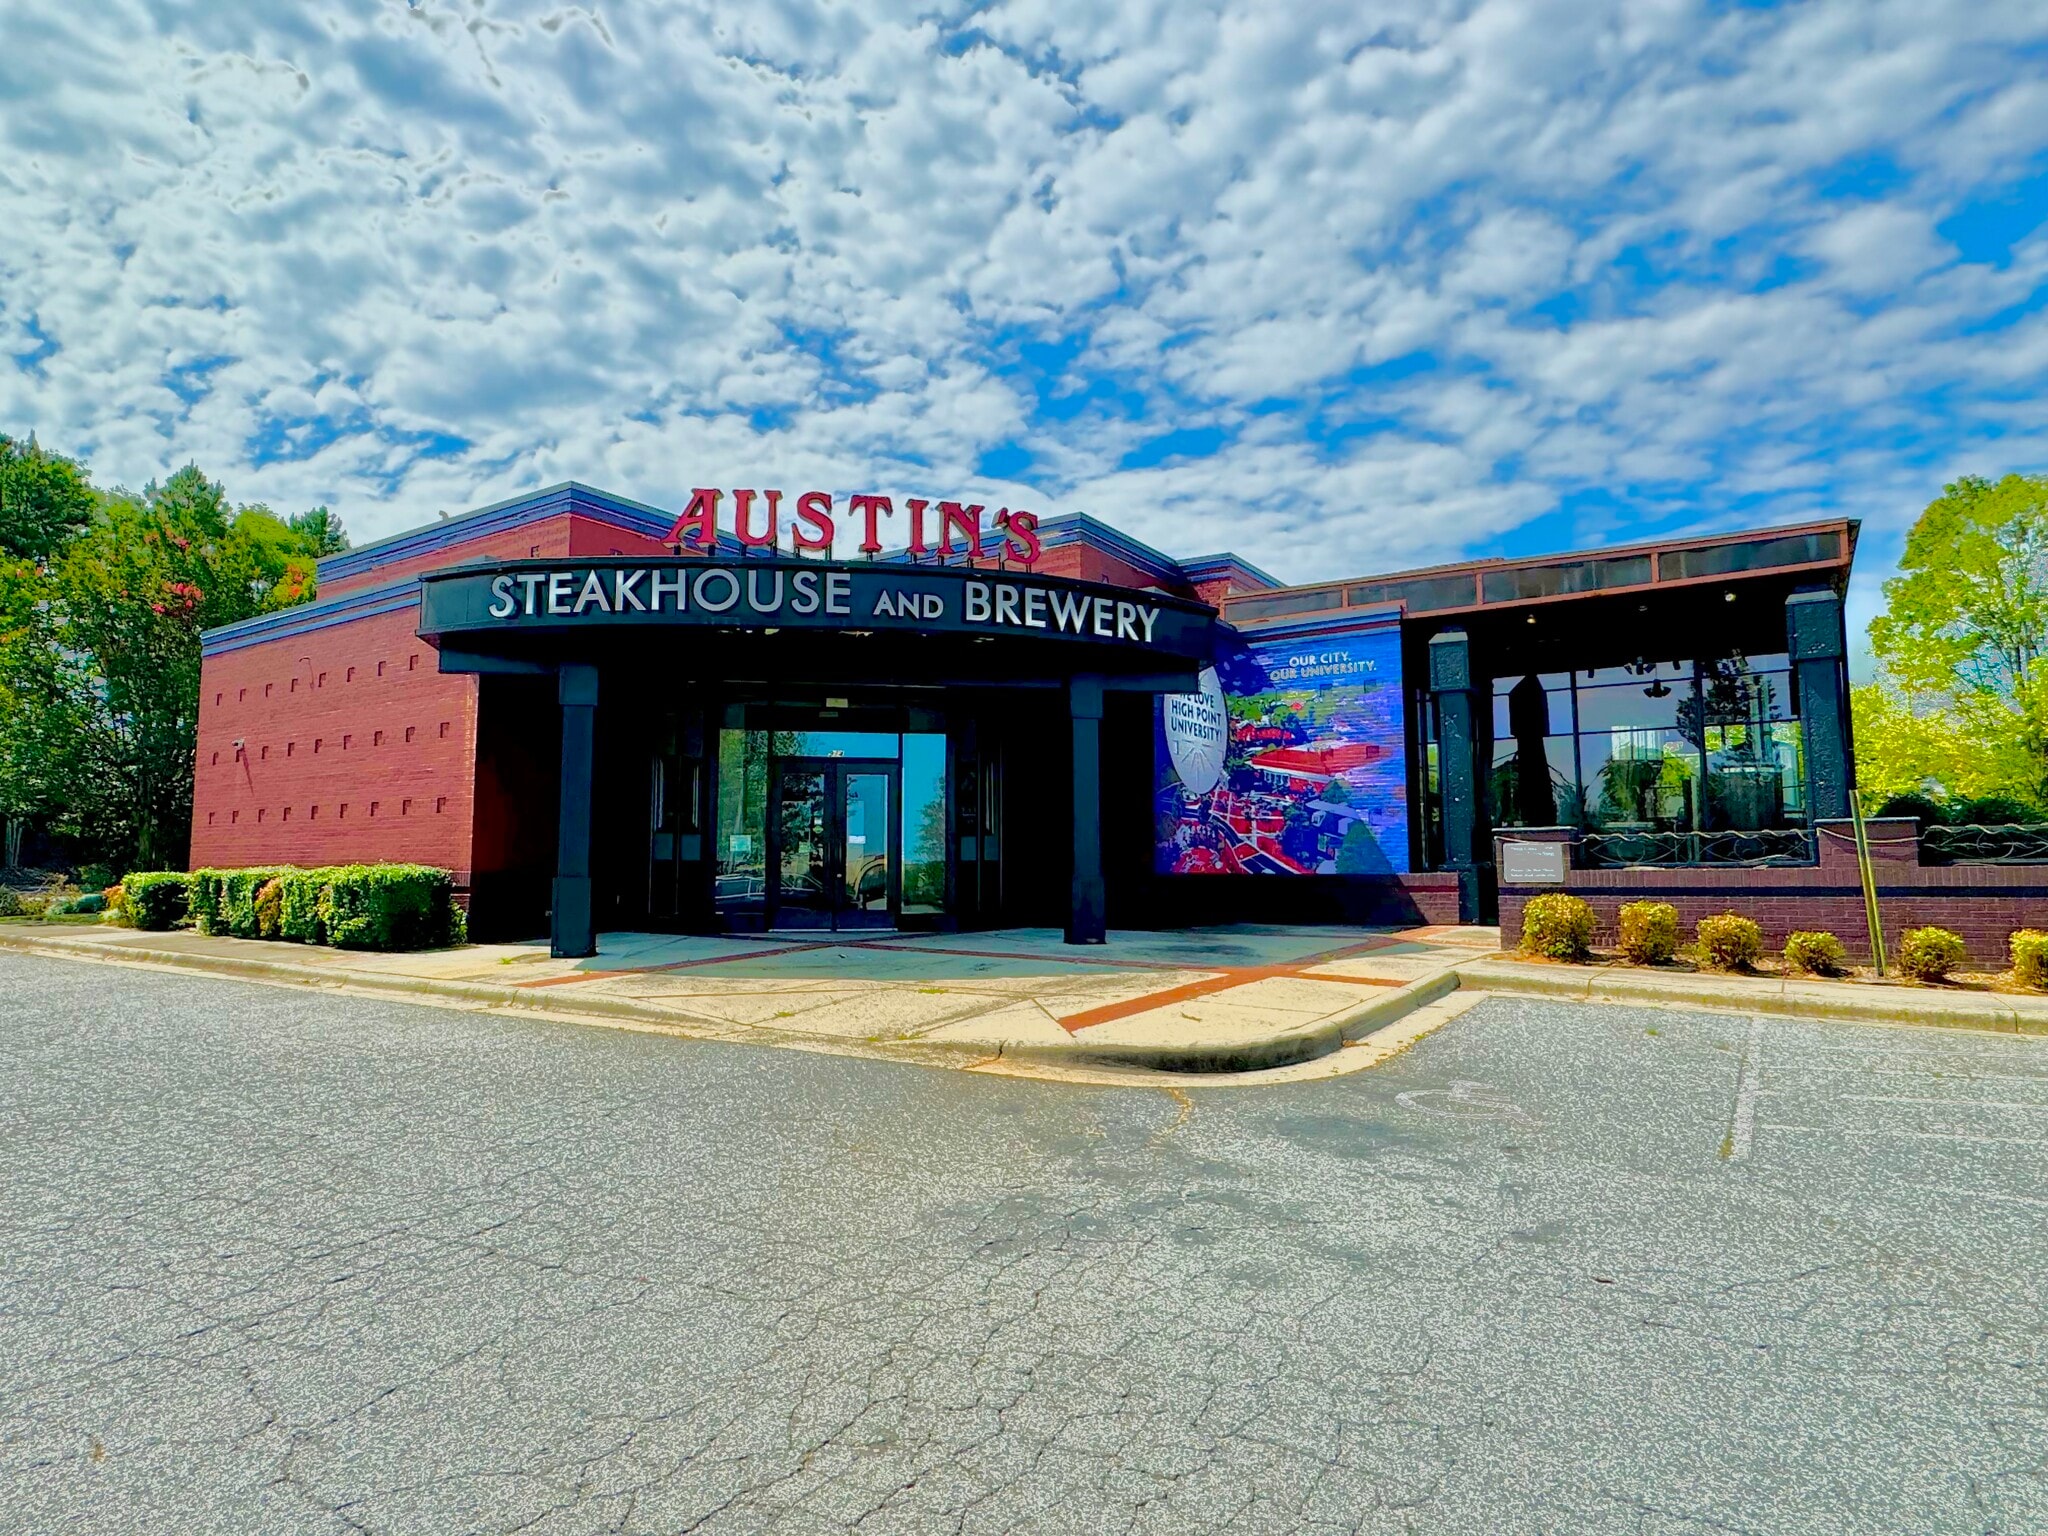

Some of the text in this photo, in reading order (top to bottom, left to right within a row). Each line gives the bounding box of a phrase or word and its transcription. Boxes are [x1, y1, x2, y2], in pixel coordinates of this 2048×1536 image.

[660, 488, 1041, 565] AUSTIN'S
[488, 568, 1160, 643] STEAKHOUSE AND BREWERY
[1269, 660, 1377, 681] OUR UNIVERSITY.
[1288, 651, 1352, 668] OUR CITY.
[1194, 691, 1214, 709] LOVE
[1171, 699, 1222, 727] HIGH POINT
